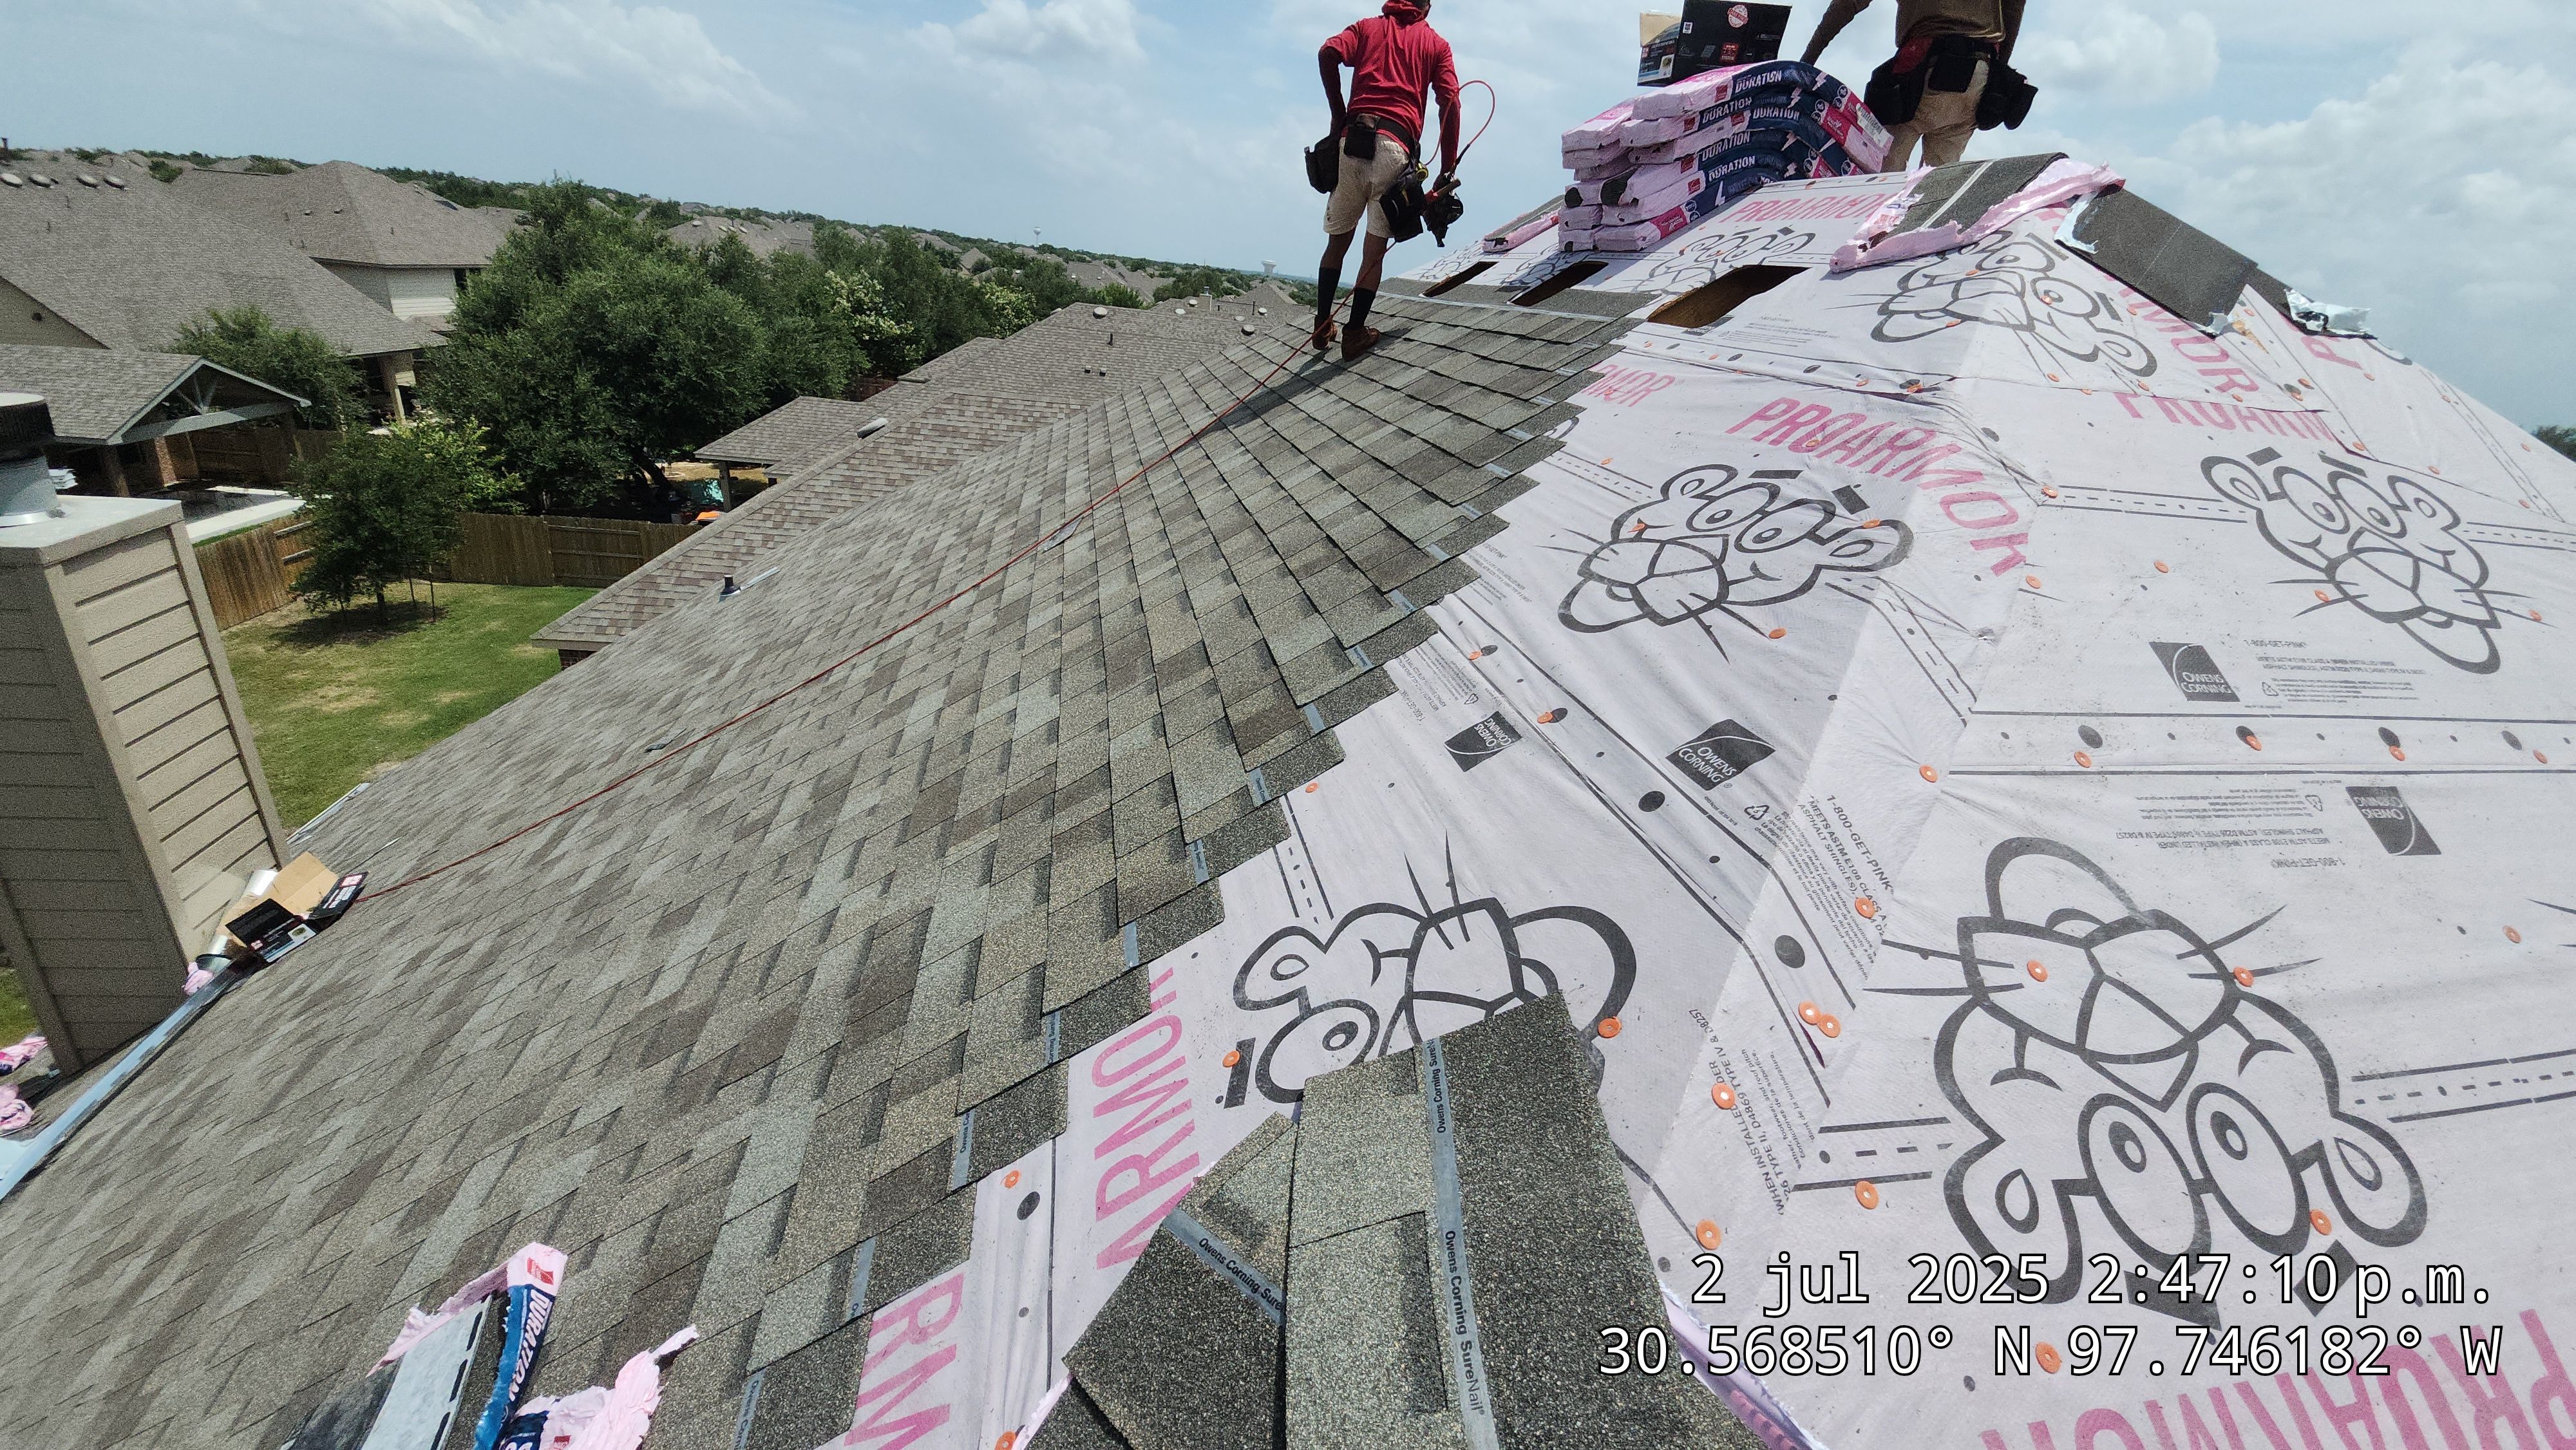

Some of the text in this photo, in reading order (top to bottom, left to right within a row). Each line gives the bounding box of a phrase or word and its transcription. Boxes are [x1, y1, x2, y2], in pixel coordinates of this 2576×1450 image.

[1735, 70, 1783, 93] DURATION
[1702, 97, 1752, 124] DURATION
[1702, 131, 1750, 161] DURATION
[1709, 155, 1756, 182] DURATION
[1719, 194, 1900, 223] PROARMO
[1725, 397, 2029, 576] PROARMOR
[2181, 682, 2232, 693] CORNING
[2183, 672, 2224, 683] OWENS
[1474, 723, 1497, 747] OWENS
[1484, 718, 1511, 746] CORNING
[1679, 748, 1724, 782] CORNING
[1698, 747, 1737, 776] OWENS
[1798, 804, 1827, 842] ASPHALT
[2361, 809, 2404, 820] OWENS
[1809, 800, 1831, 829] MEETS
[1827, 831, 1848, 857] ASTM
[1844, 858, 1861, 881] E108
[1860, 883, 1882, 913] CLASS
[1714, 1044, 1726, 1058] IV
[1432, 1068, 1443, 1103] Corning
[1720, 1059, 1741, 1090] TYPE
[1437, 1104, 1446, 1133] Owens
[1737, 1090, 1761, 1130] D4869
[1730, 1103, 1766, 1169] INSTALLED
[1763, 1144, 1784, 1179] TYPE
[1198, 1238, 1227, 1264] Owens
[1226, 1260, 1261, 1294] Corning
[1444, 1230, 1457, 1274] Owens
[1450, 1276, 1468, 1335] Corning
